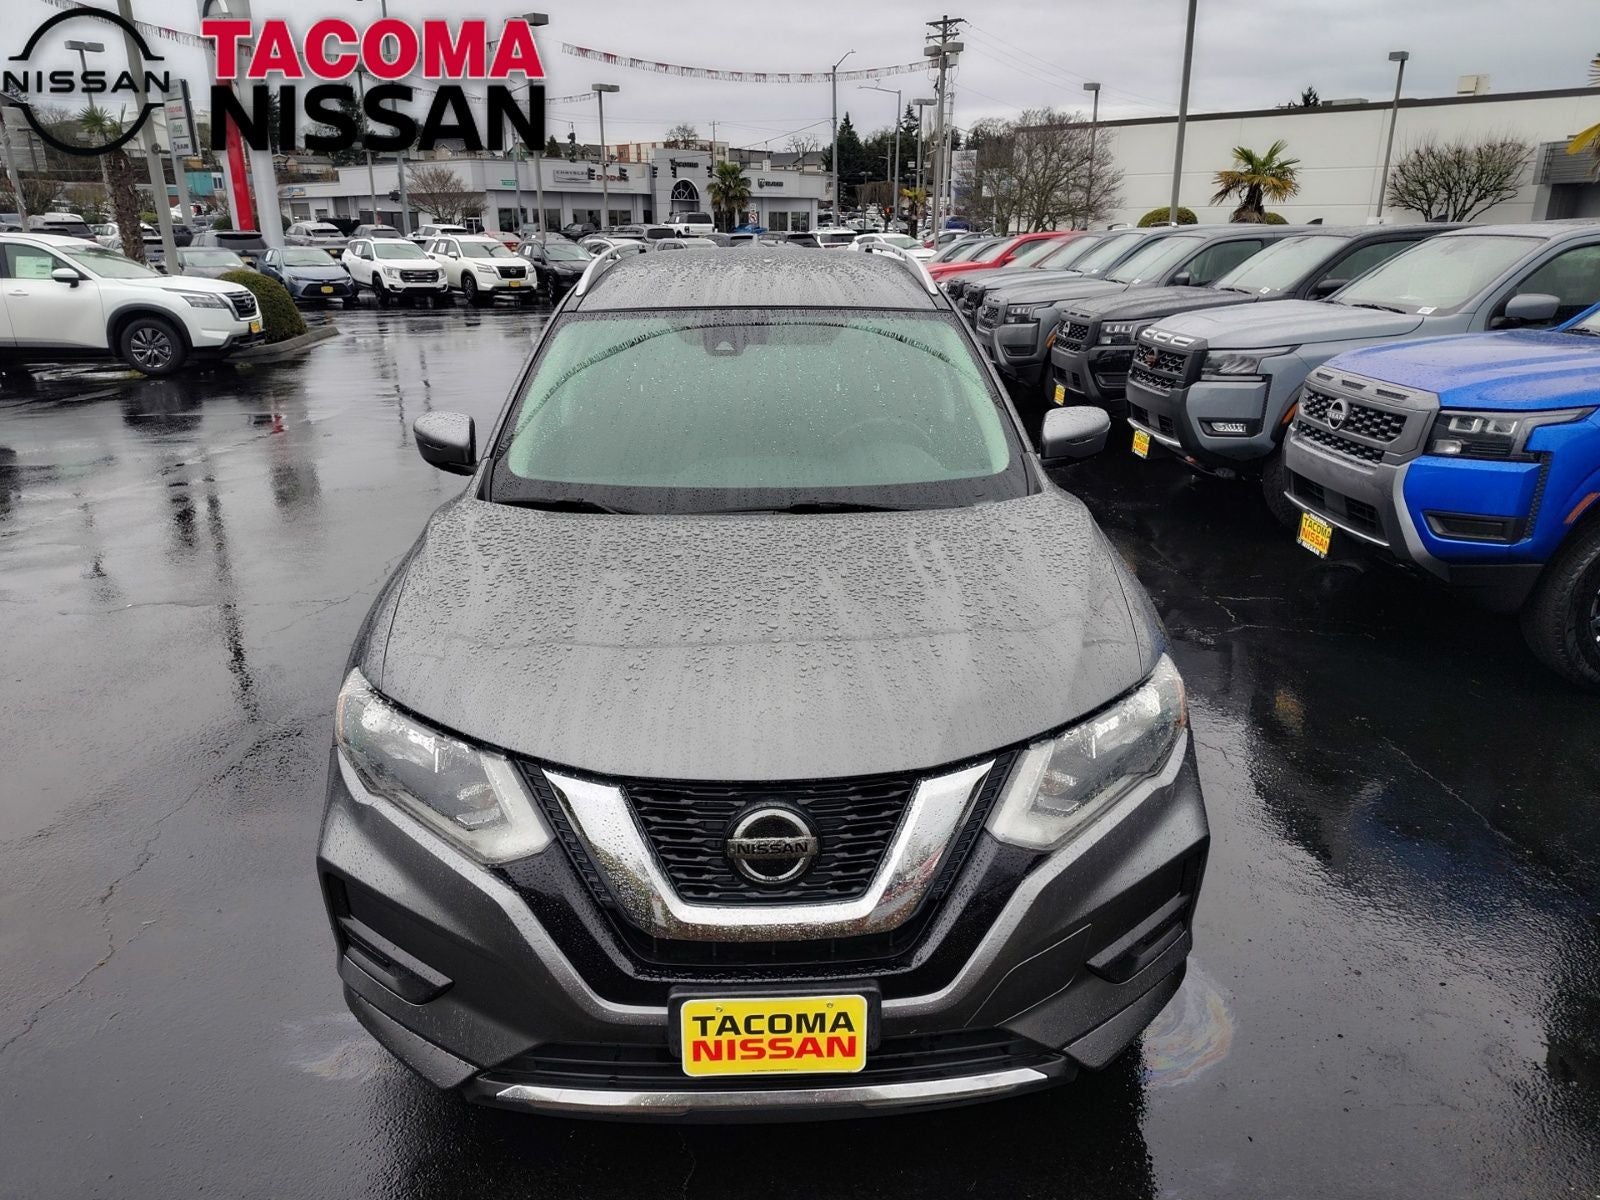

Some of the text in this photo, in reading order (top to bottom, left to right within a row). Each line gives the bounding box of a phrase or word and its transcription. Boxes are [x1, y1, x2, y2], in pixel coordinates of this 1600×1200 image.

[1301, 527, 1329, 550] NISSAN
[736, 841, 808, 855] NISSAN
[692, 1011, 855, 1037] TACOMA
[692, 1036, 856, 1062] NISSAN
